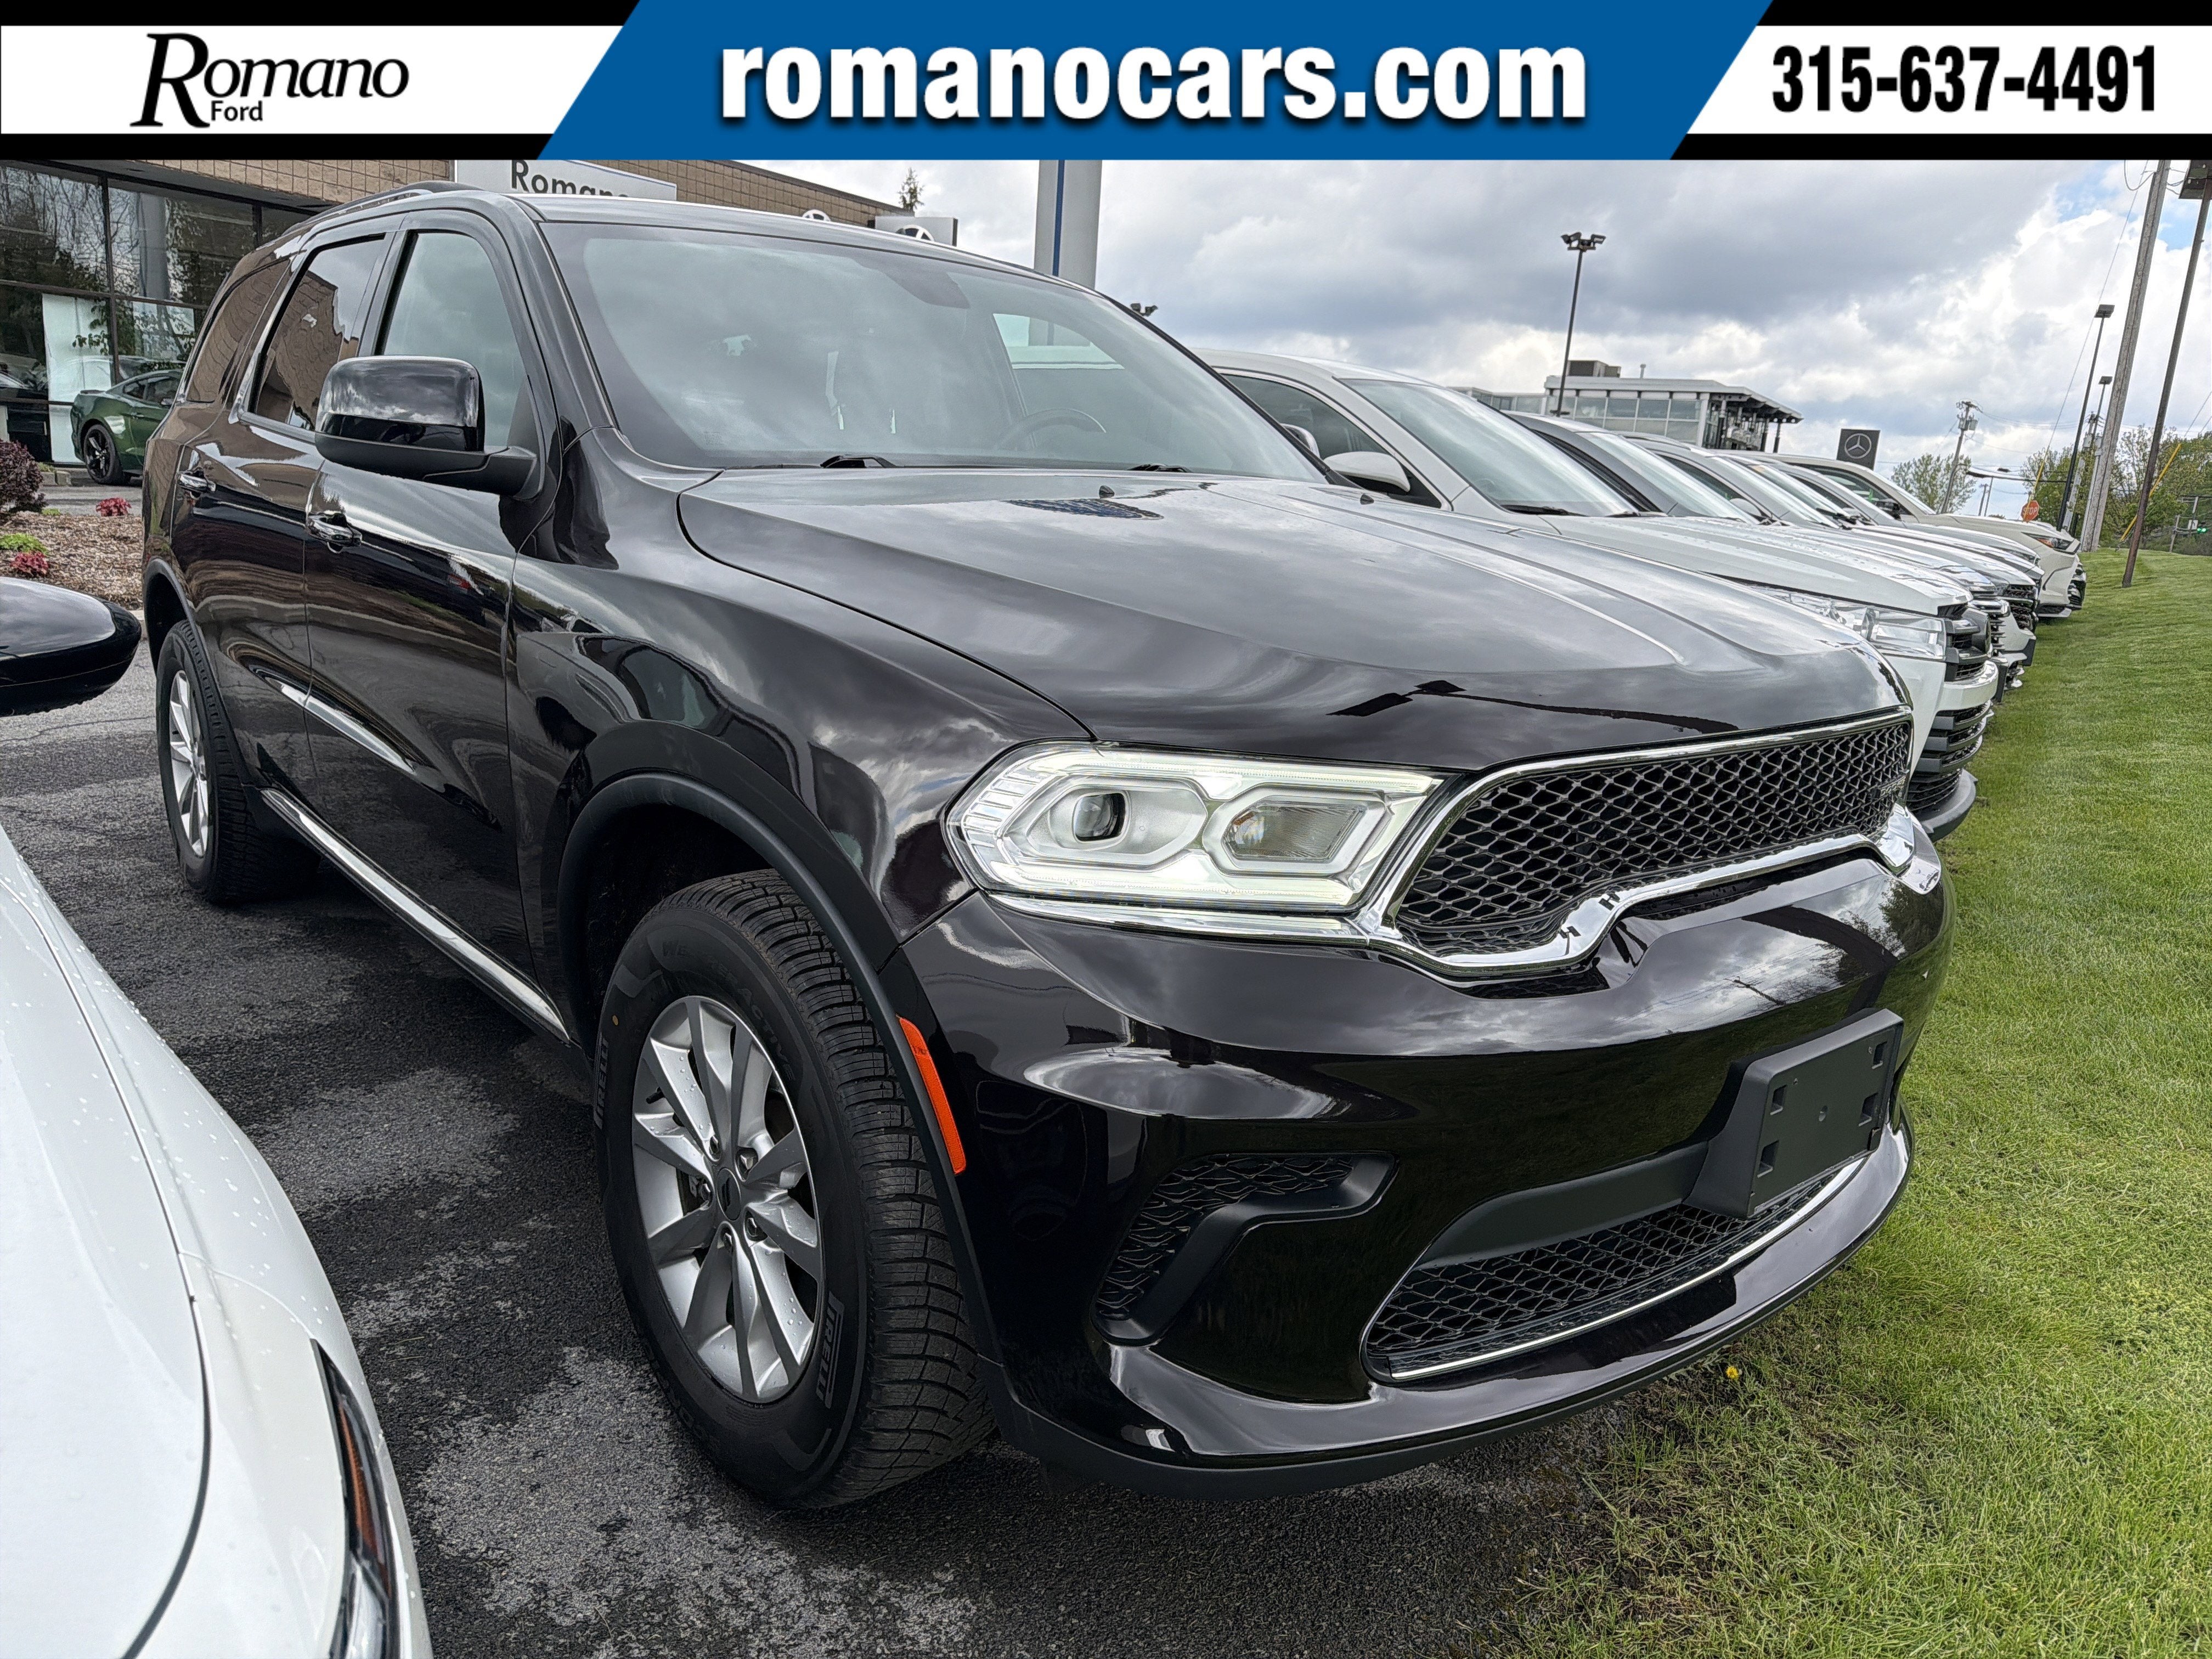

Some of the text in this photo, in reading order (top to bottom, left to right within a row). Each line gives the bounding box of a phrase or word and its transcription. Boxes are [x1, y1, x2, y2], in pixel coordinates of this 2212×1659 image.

[511, 160, 629, 196] Roma
[2022, 506, 2038, 515] STOP
[816, 1290, 845, 1409] PIRELLI
